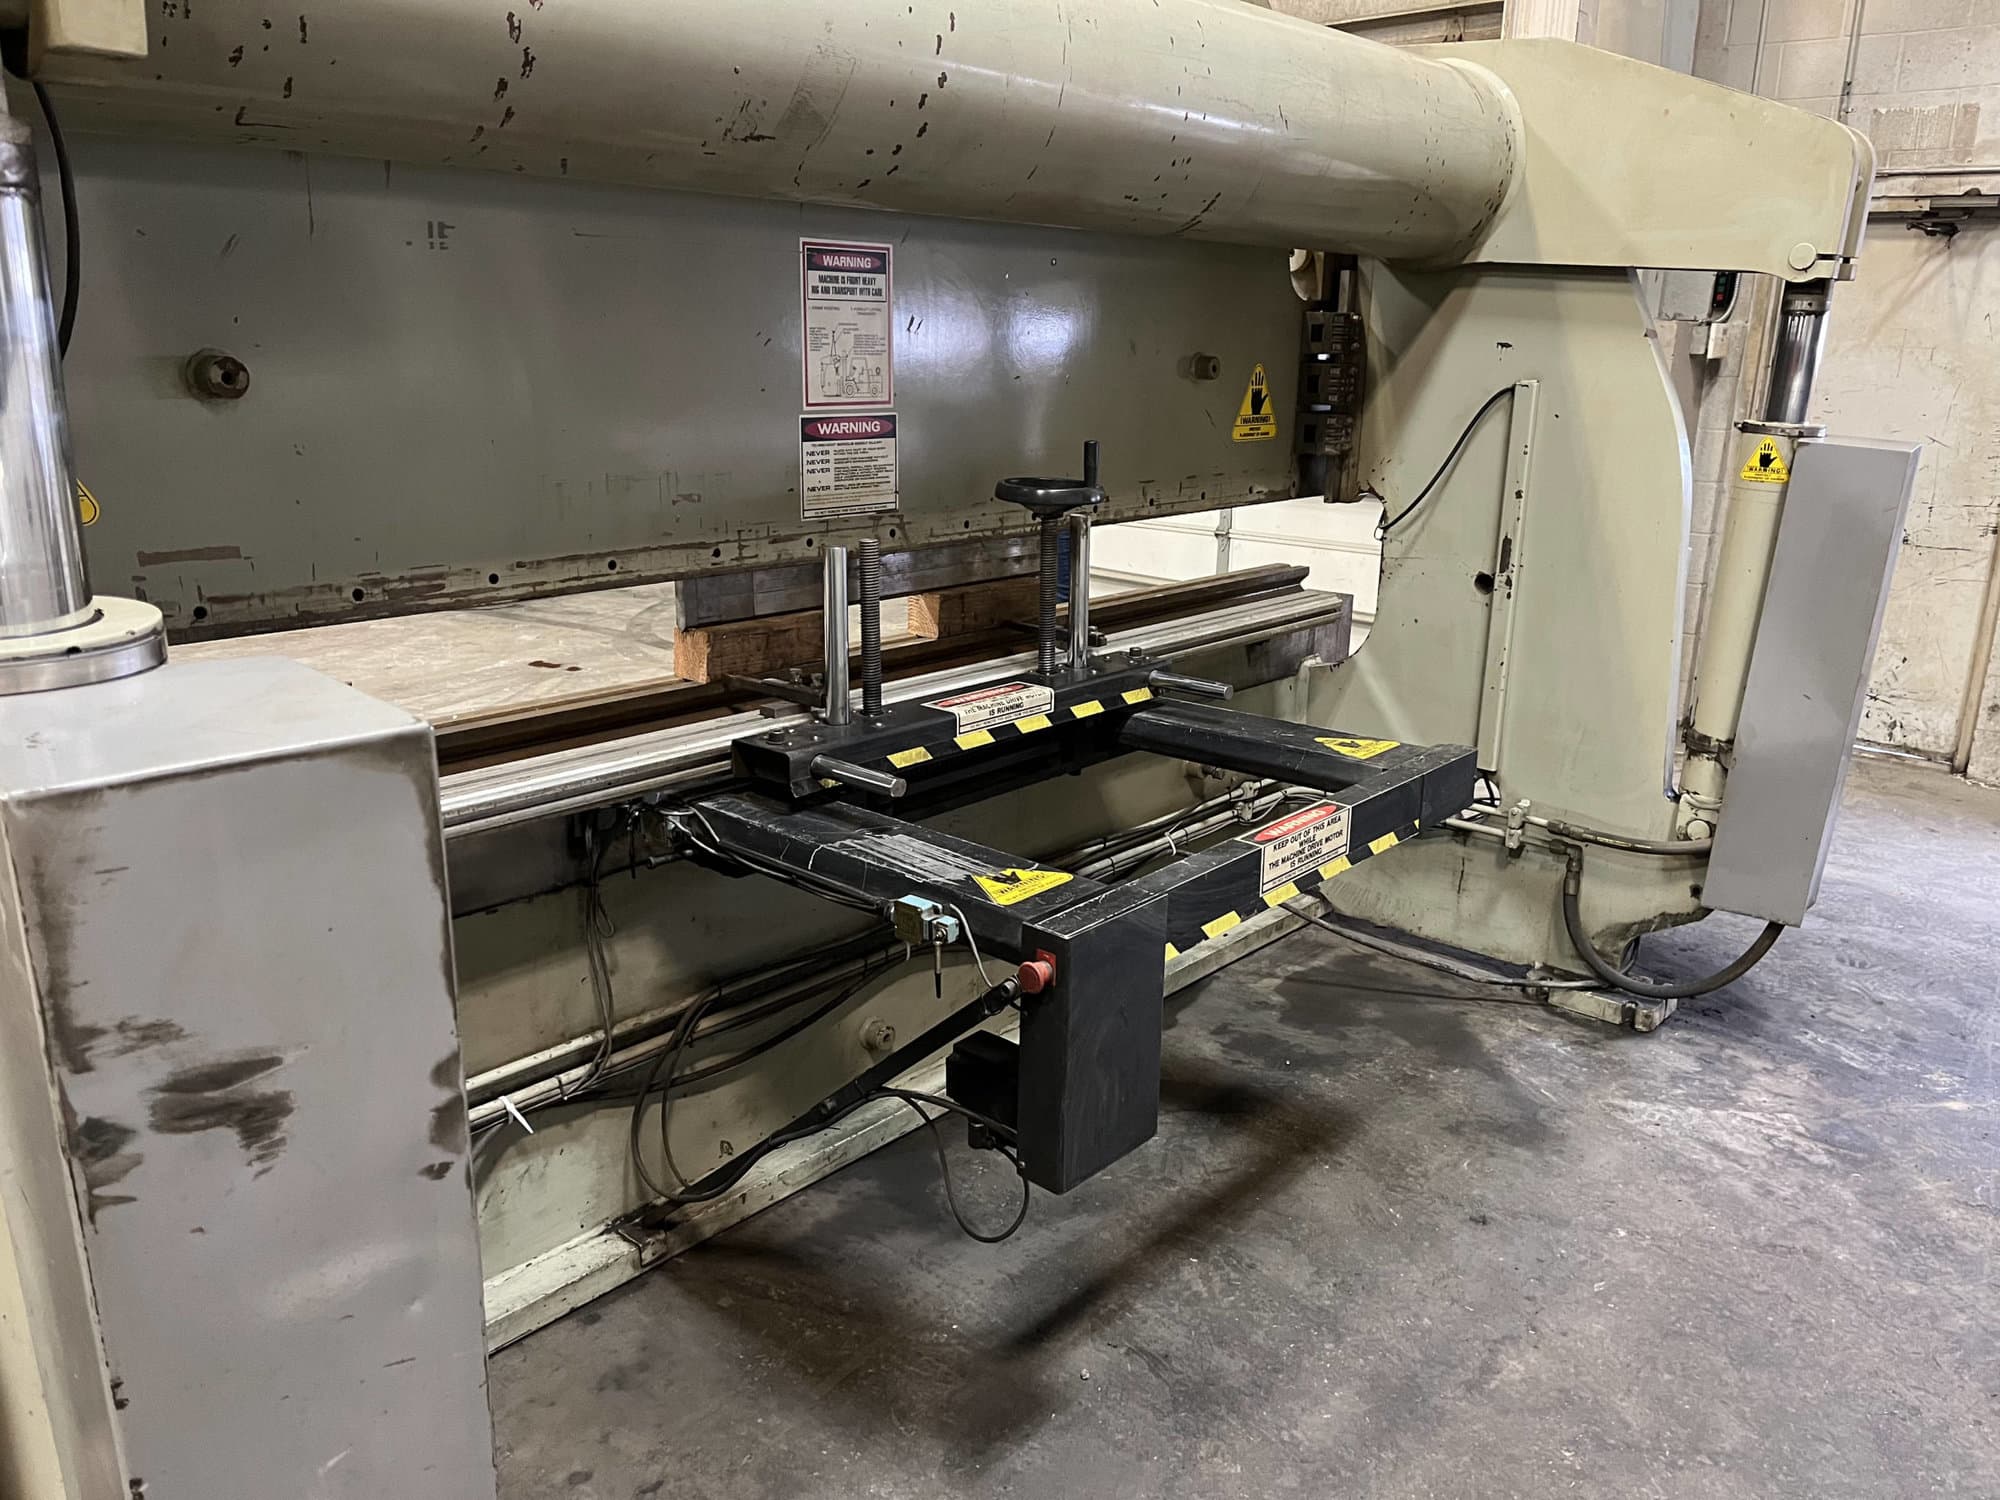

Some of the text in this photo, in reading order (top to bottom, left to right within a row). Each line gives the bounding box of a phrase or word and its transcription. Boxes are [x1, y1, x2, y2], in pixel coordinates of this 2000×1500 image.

[822, 255, 872, 269] WARNING
[818, 274, 840, 284] MACHINE
[862, 277, 876, 286] HEAVY
[820, 286, 831, 295] AND
[831, 286, 858, 296] TRANSPORT
[859, 287, 871, 296] WITH
[871, 288, 883, 297] CARE
[817, 421, 881, 435] WARNING
[1006, 695, 1024, 706] DRIVE
[988, 702, 1025, 716] IS RUNNING
[1264, 808, 1328, 837] WARNING
[1272, 815, 1342, 852] KEEP OUT OF THIS AREA
[1298, 834, 1317, 848] WHILE
[1268, 829, 1344, 870] THE MACHINE DRIVE MOTOR
[1289, 847, 1323, 868] IS RUNNING
